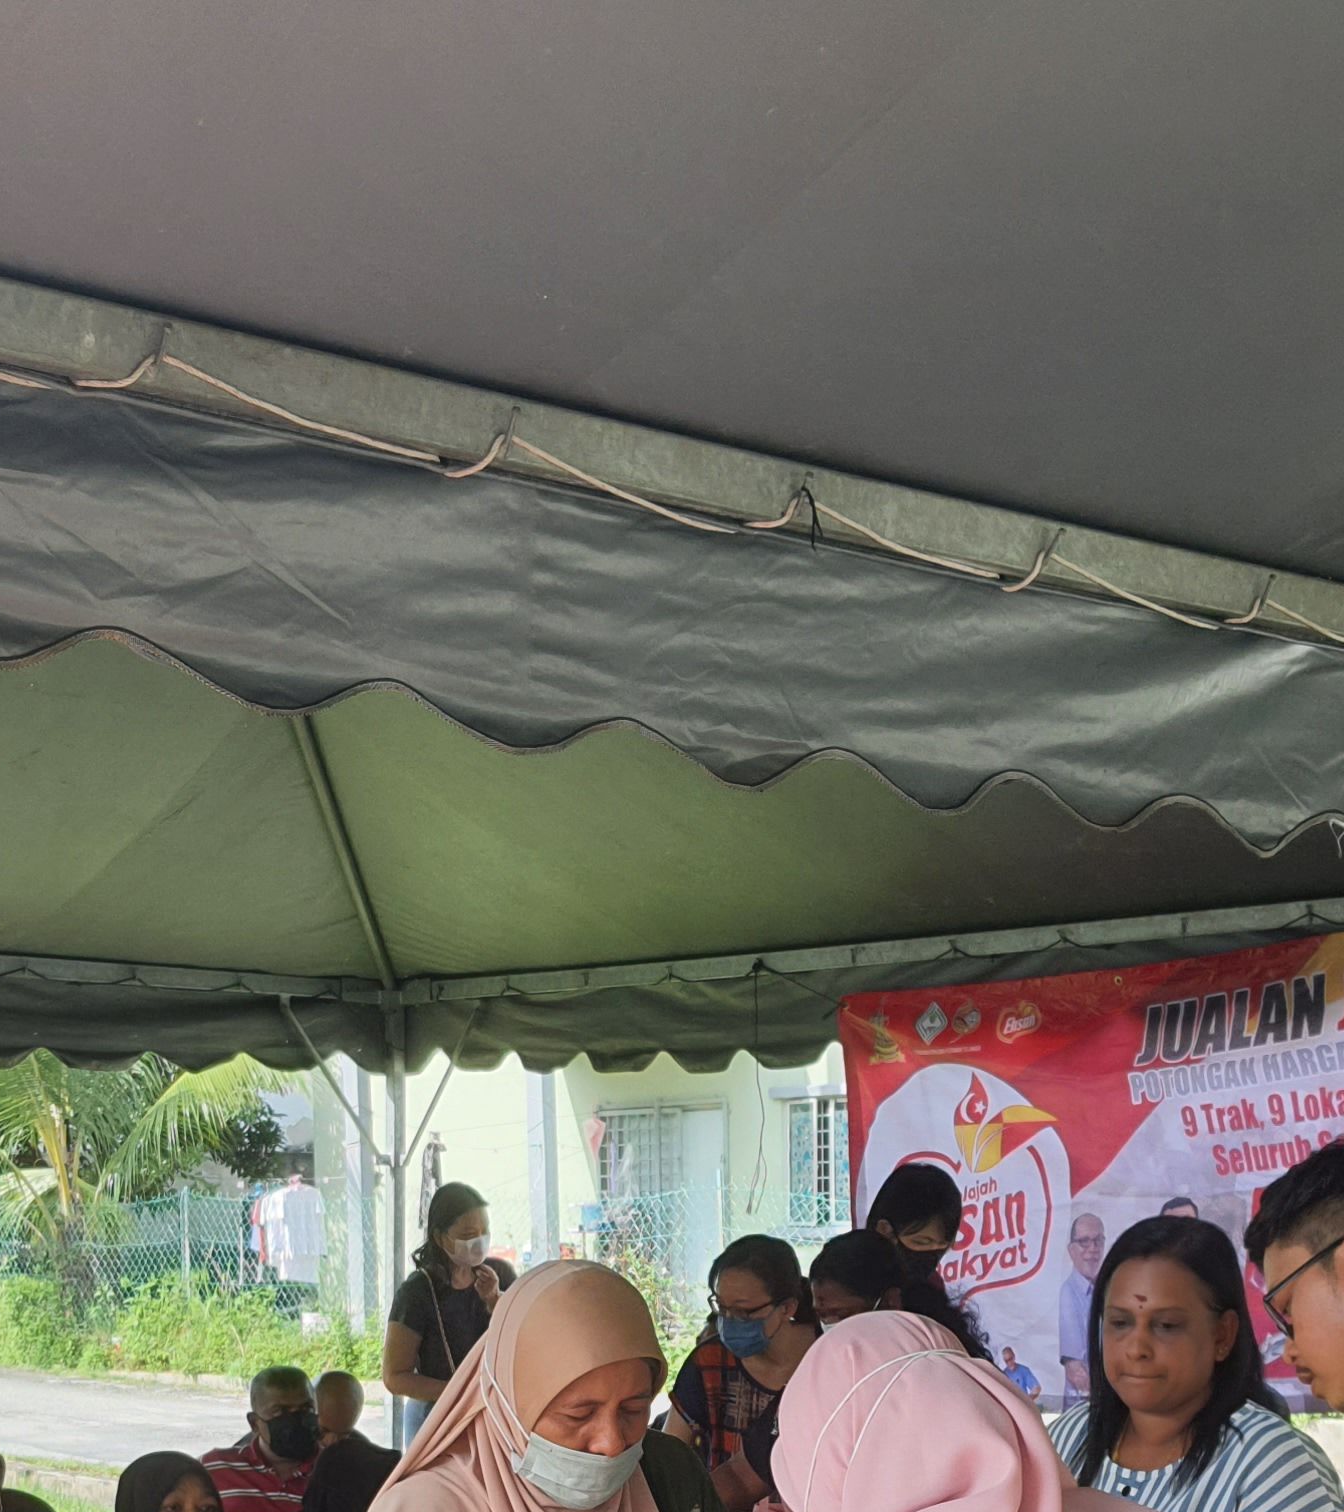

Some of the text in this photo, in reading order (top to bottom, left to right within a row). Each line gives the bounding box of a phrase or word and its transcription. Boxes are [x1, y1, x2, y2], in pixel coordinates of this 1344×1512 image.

[1135, 973, 1326, 1066] JUALAN
[1130, 1063, 1258, 1104] POTONGAN
[1181, 1105, 1197, 1137] 9
[1201, 1099, 1265, 1134] Trak,
[1269, 1094, 1286, 1127] 9
[1213, 1132, 1313, 1176] Seluruh
[963, 1177, 997, 1201] lajah
[952, 1191, 1026, 1251] san
[937, 1239, 1028, 1282] akyat
